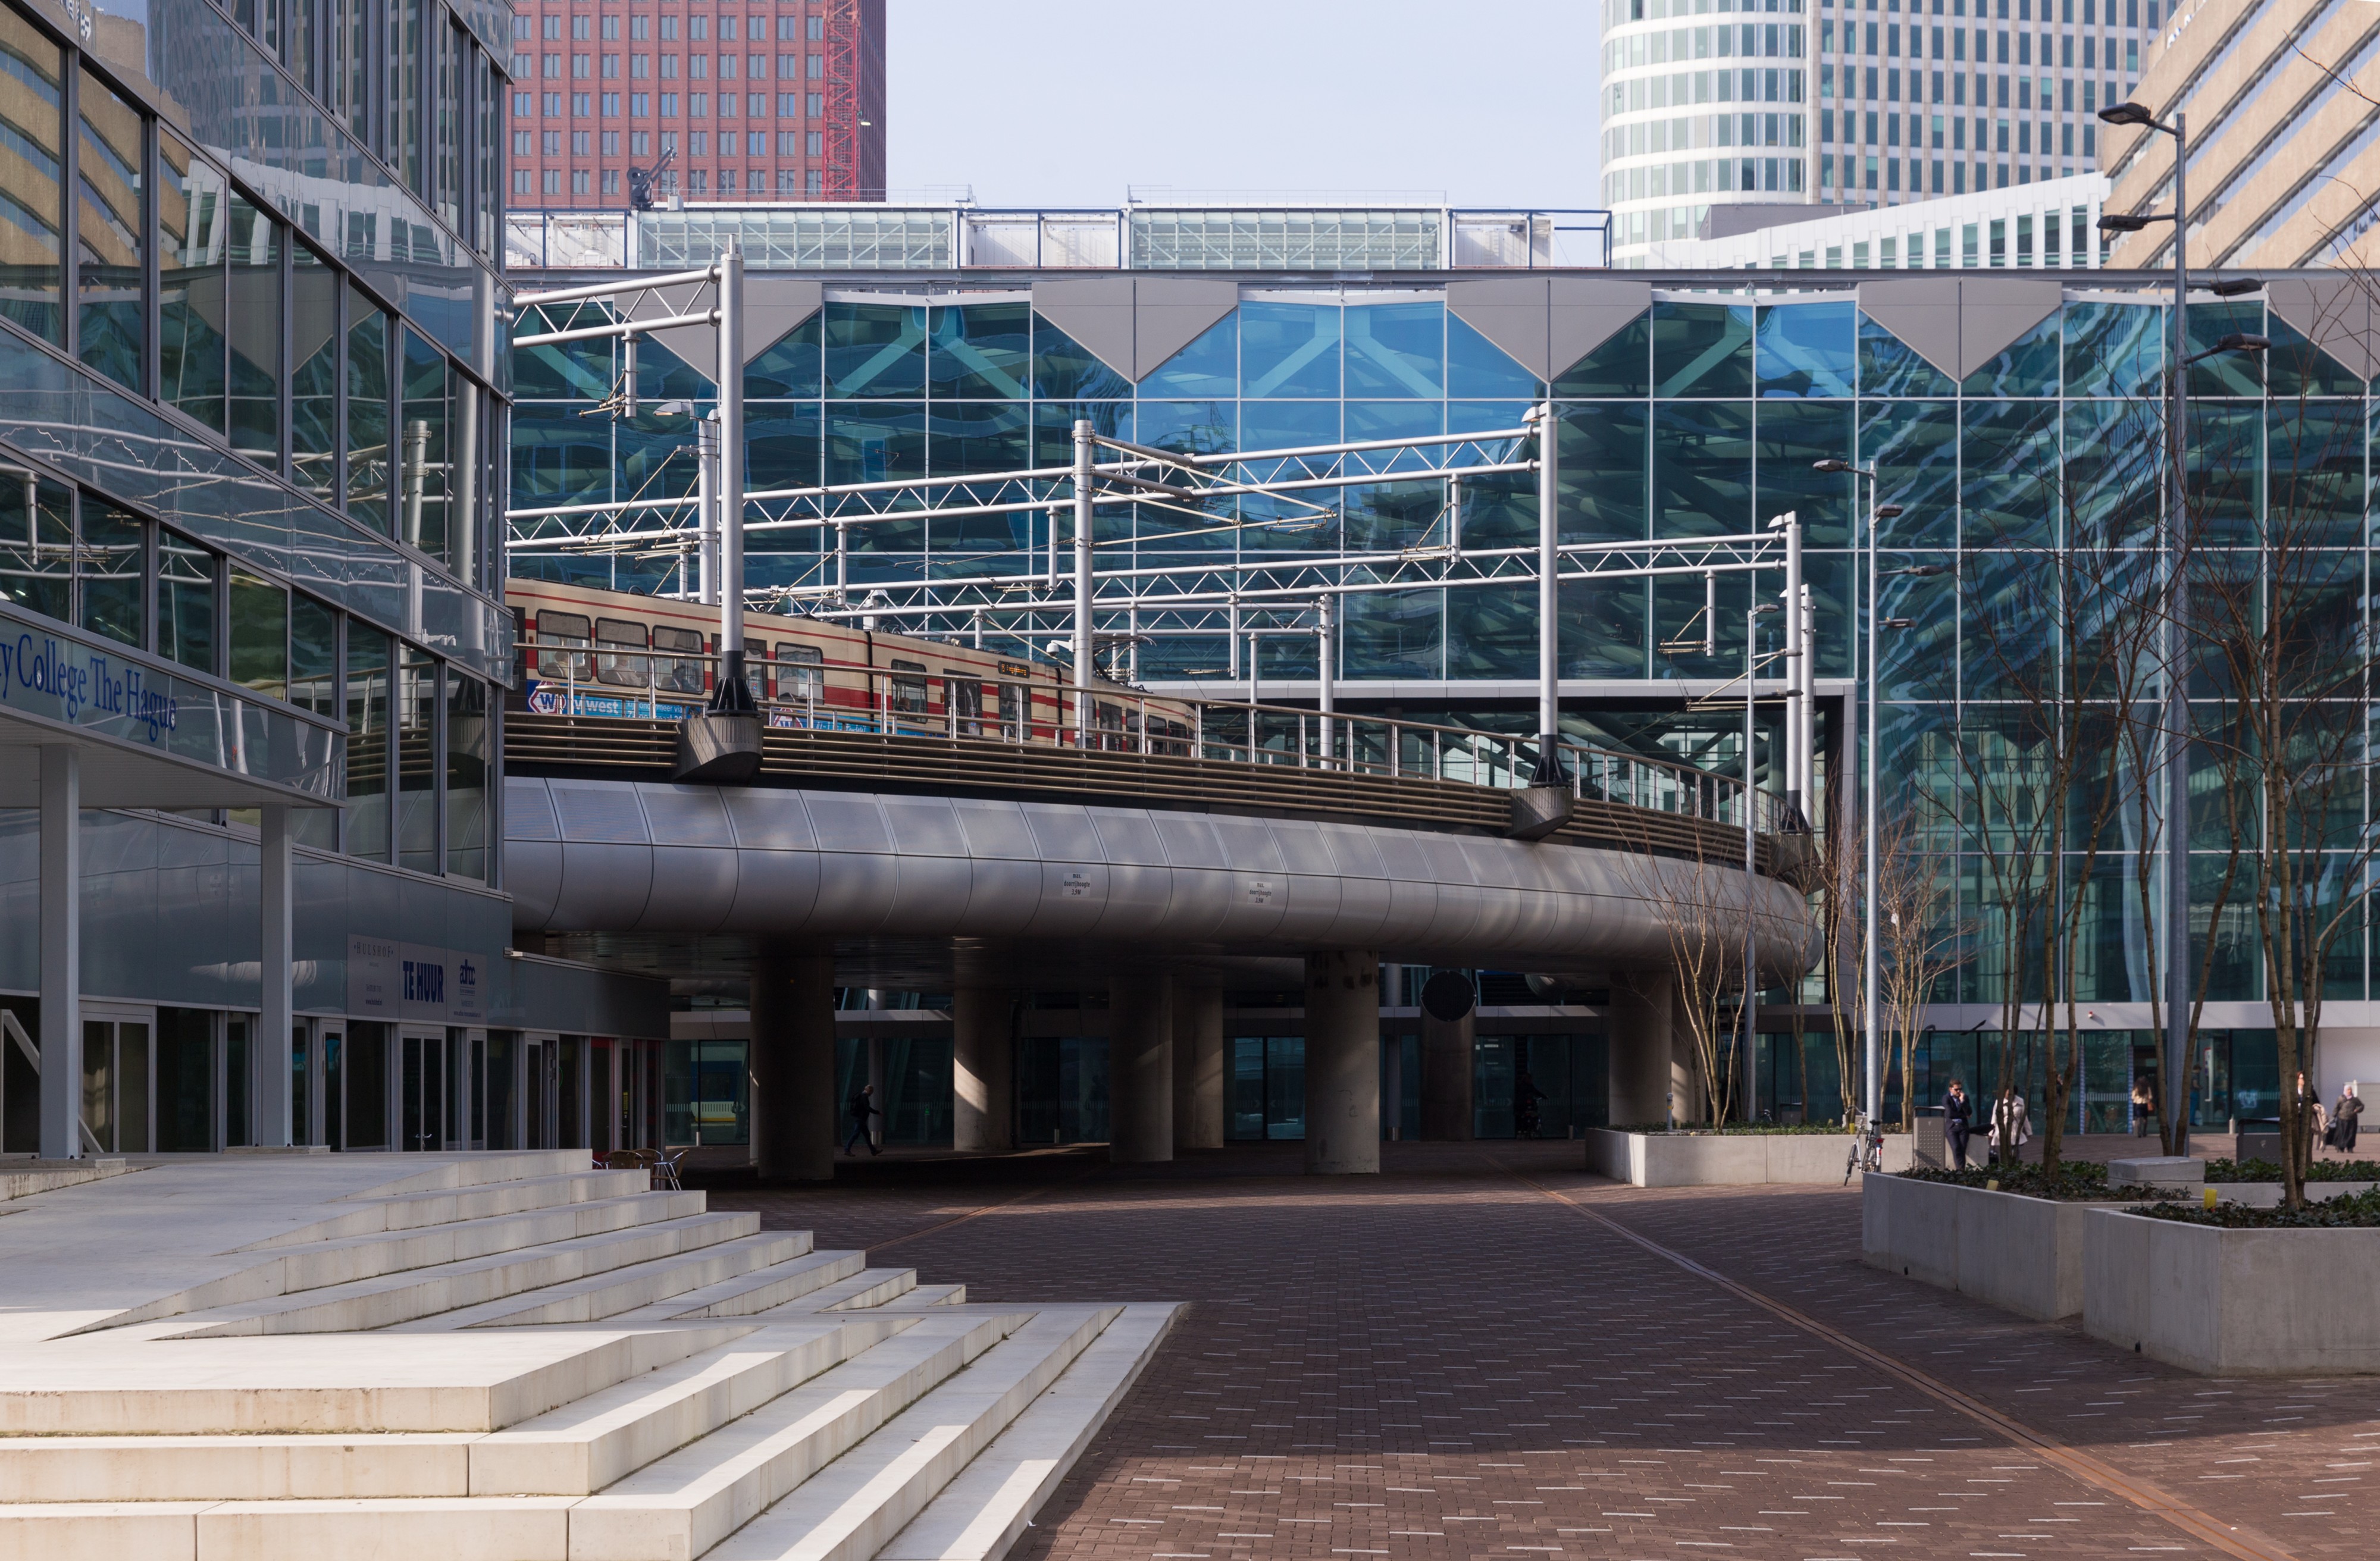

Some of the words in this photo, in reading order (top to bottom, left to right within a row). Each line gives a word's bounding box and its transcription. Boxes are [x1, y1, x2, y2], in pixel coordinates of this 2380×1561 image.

[0, 642, 13, 700] y
[17, 634, 87, 719] College
[90, 656, 122, 714] The
[126, 669, 176, 742] Hague
[586, 700, 619, 714] west
[1064, 880, 1090, 889] doorrijhoogte
[357, 942, 391, 957] HULSHOF
[403, 961, 414, 1000] TE
[416, 962, 444, 1004] HUUR
